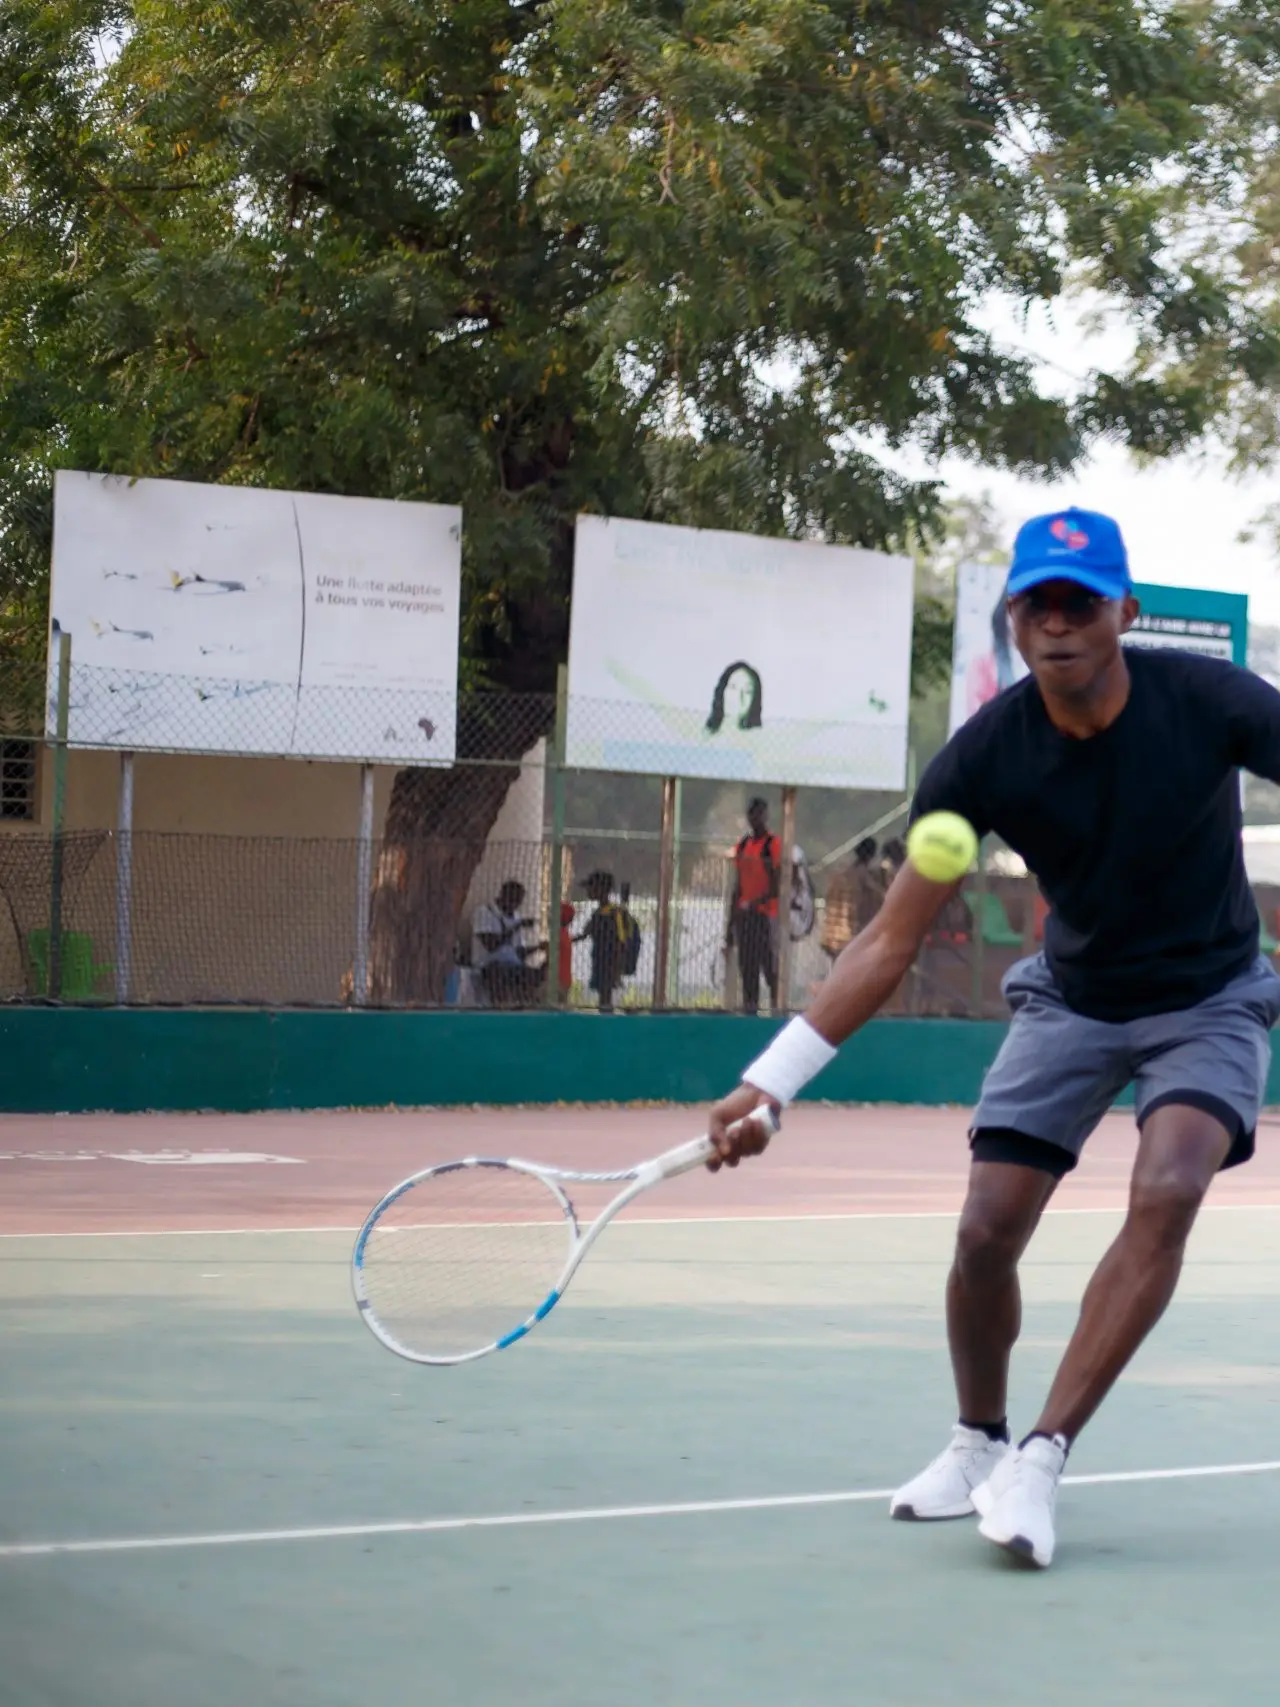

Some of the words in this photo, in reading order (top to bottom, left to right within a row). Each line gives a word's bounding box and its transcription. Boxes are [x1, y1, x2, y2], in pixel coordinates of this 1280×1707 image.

[316, 574, 344, 589] Une
[387, 580, 442, 597] adaptée
[328, 592, 358, 606] tous
[362, 597, 385, 608] vos
[388, 598, 445, 614] voyages
